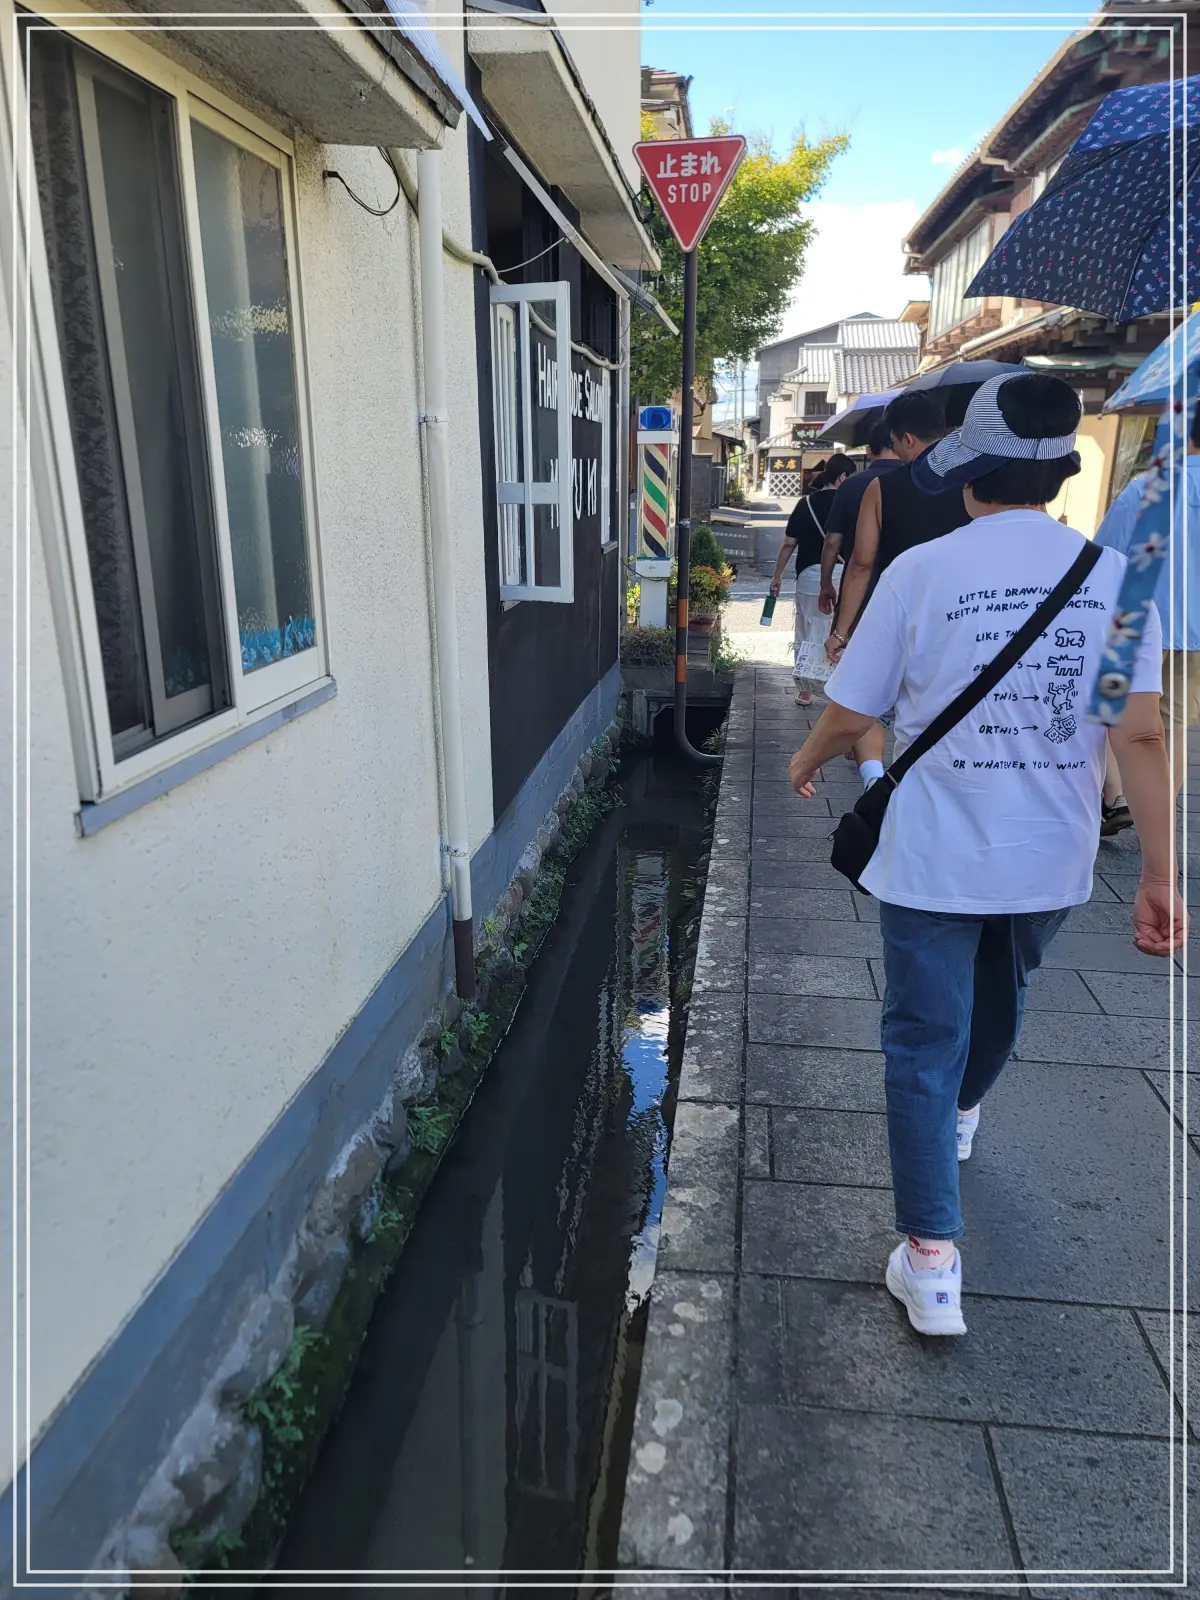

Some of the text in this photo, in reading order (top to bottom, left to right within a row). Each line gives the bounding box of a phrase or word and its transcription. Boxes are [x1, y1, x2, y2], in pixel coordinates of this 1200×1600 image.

[656, 150, 722, 179] 止まれ
[667, 182, 712, 204] STOP
[958, 586, 1091, 605] LITTLE DRAWIN OF
[946, 599, 1107, 622] KEITH HARING CACTERS.
[975, 631, 1000, 643] LIKE
[993, 692, 1019, 702] THIS
[952, 759, 967, 770] OR
[972, 759, 1027, 771] WHATEVER
[1032, 760, 1051, 770] YOU
